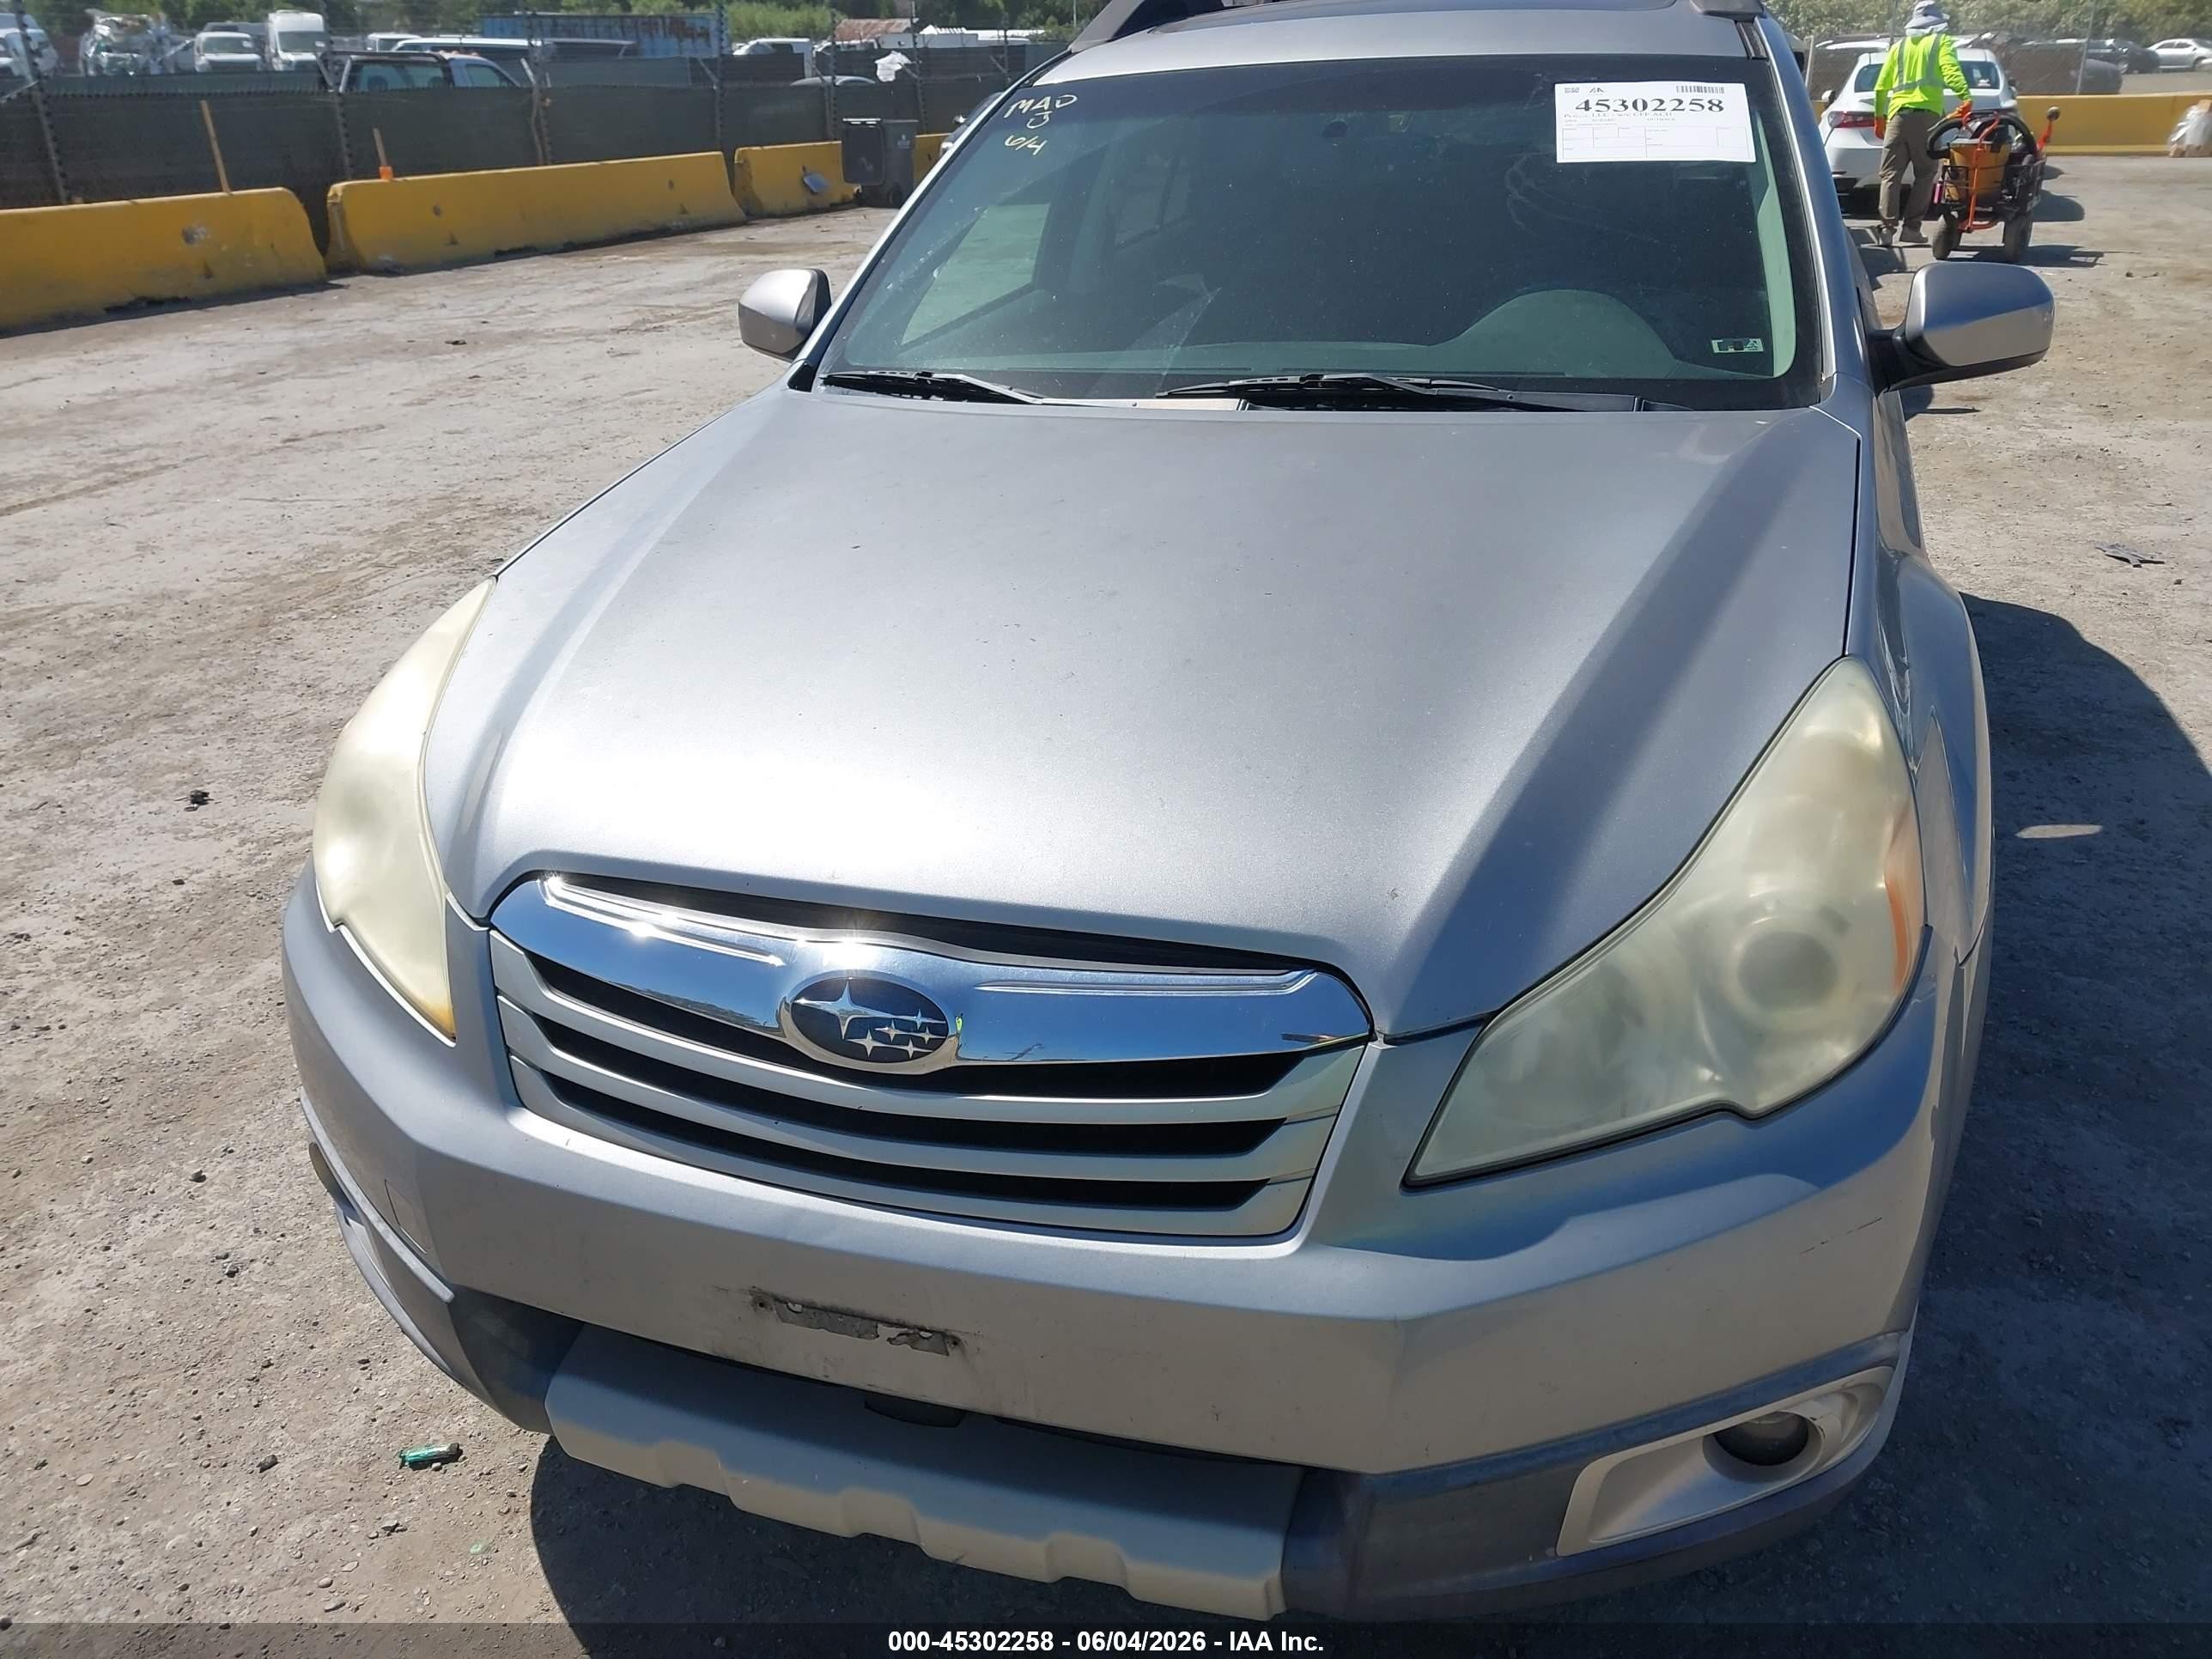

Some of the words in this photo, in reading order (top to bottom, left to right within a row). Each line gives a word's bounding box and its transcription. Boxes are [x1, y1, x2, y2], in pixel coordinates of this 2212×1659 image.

[1004, 94, 1078, 118] MAD
[1575, 98, 1724, 112] 45302258
[1005, 135, 1048, 155] 6/4
